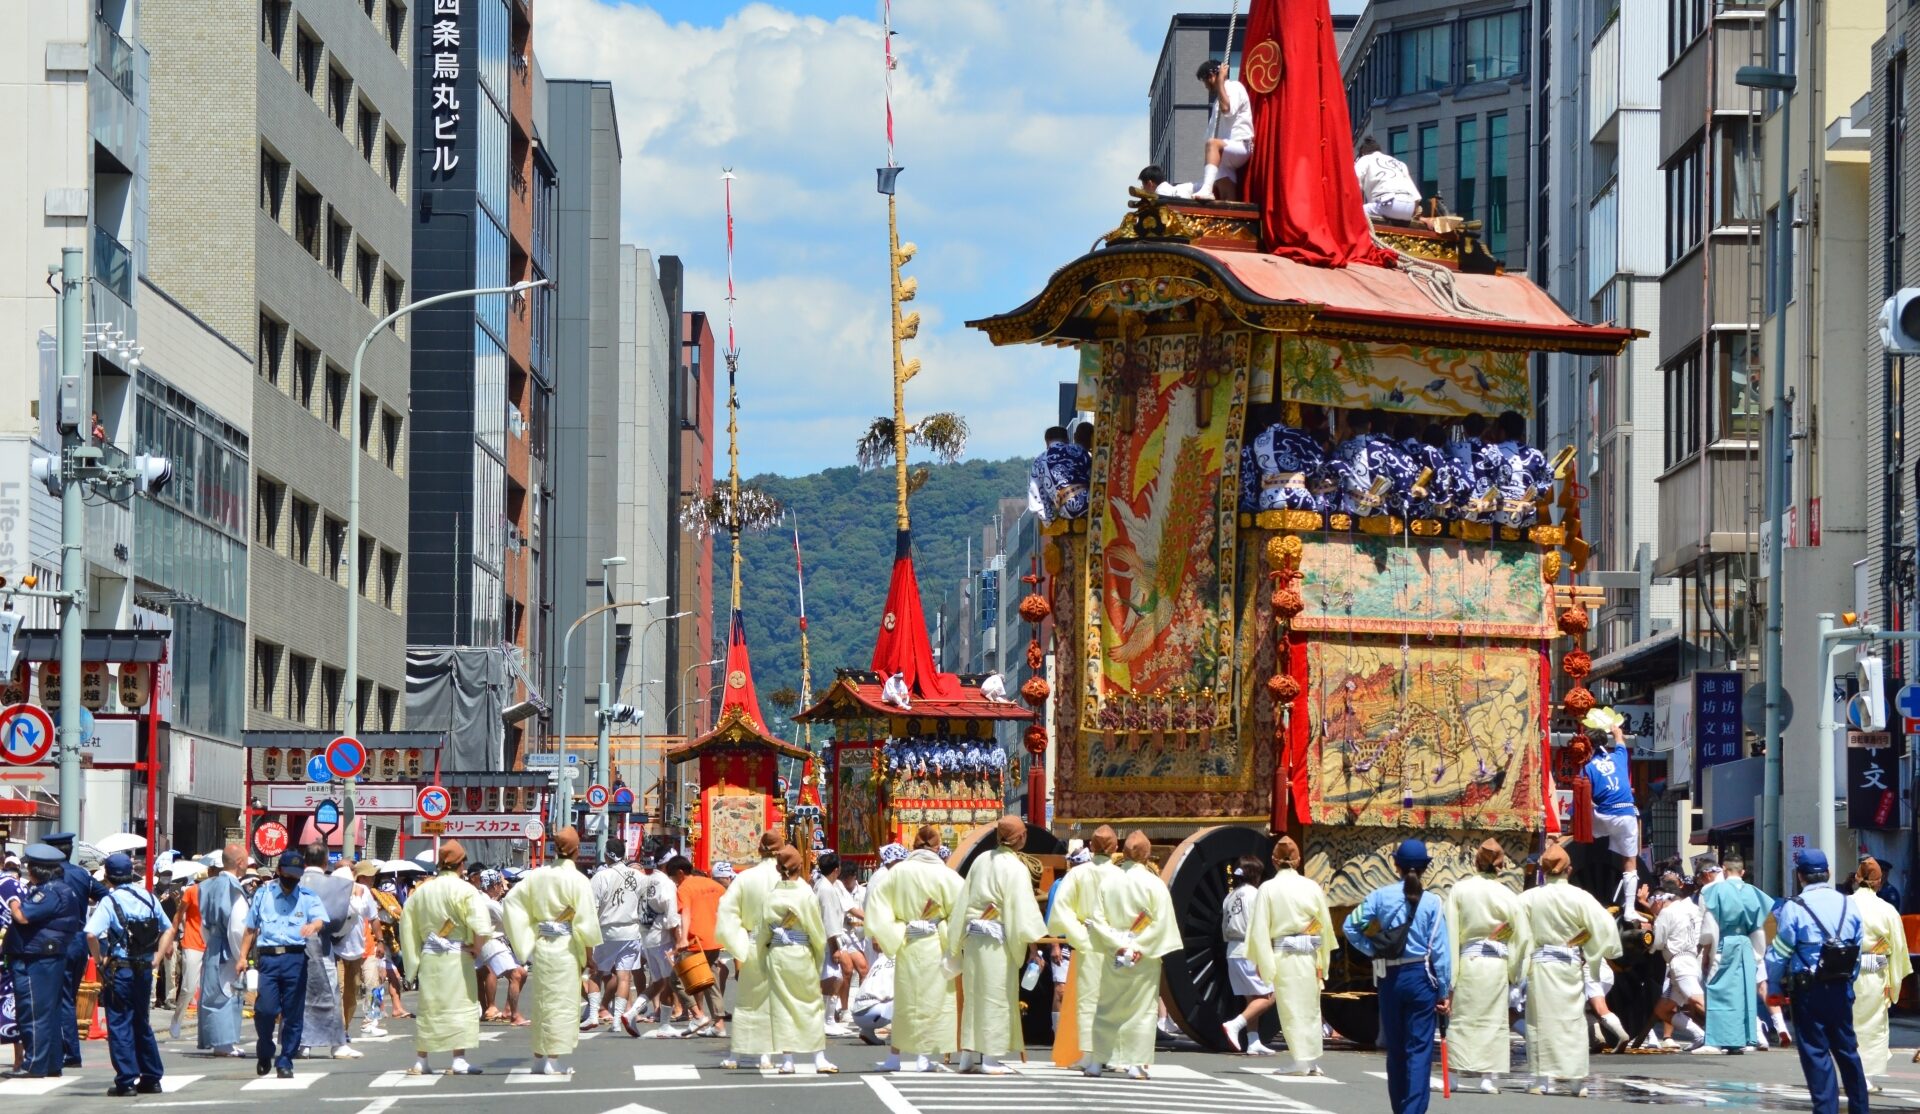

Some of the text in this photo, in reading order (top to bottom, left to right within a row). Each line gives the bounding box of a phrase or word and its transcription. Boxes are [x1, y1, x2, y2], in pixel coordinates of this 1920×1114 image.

[433, 0, 460, 171] 四条烏丸ビル
[1702, 679, 1716, 768] 池坊文化
[1721, 679, 1735, 757] 池坊短期
[444, 821, 521, 832] ホリーズカフェ
